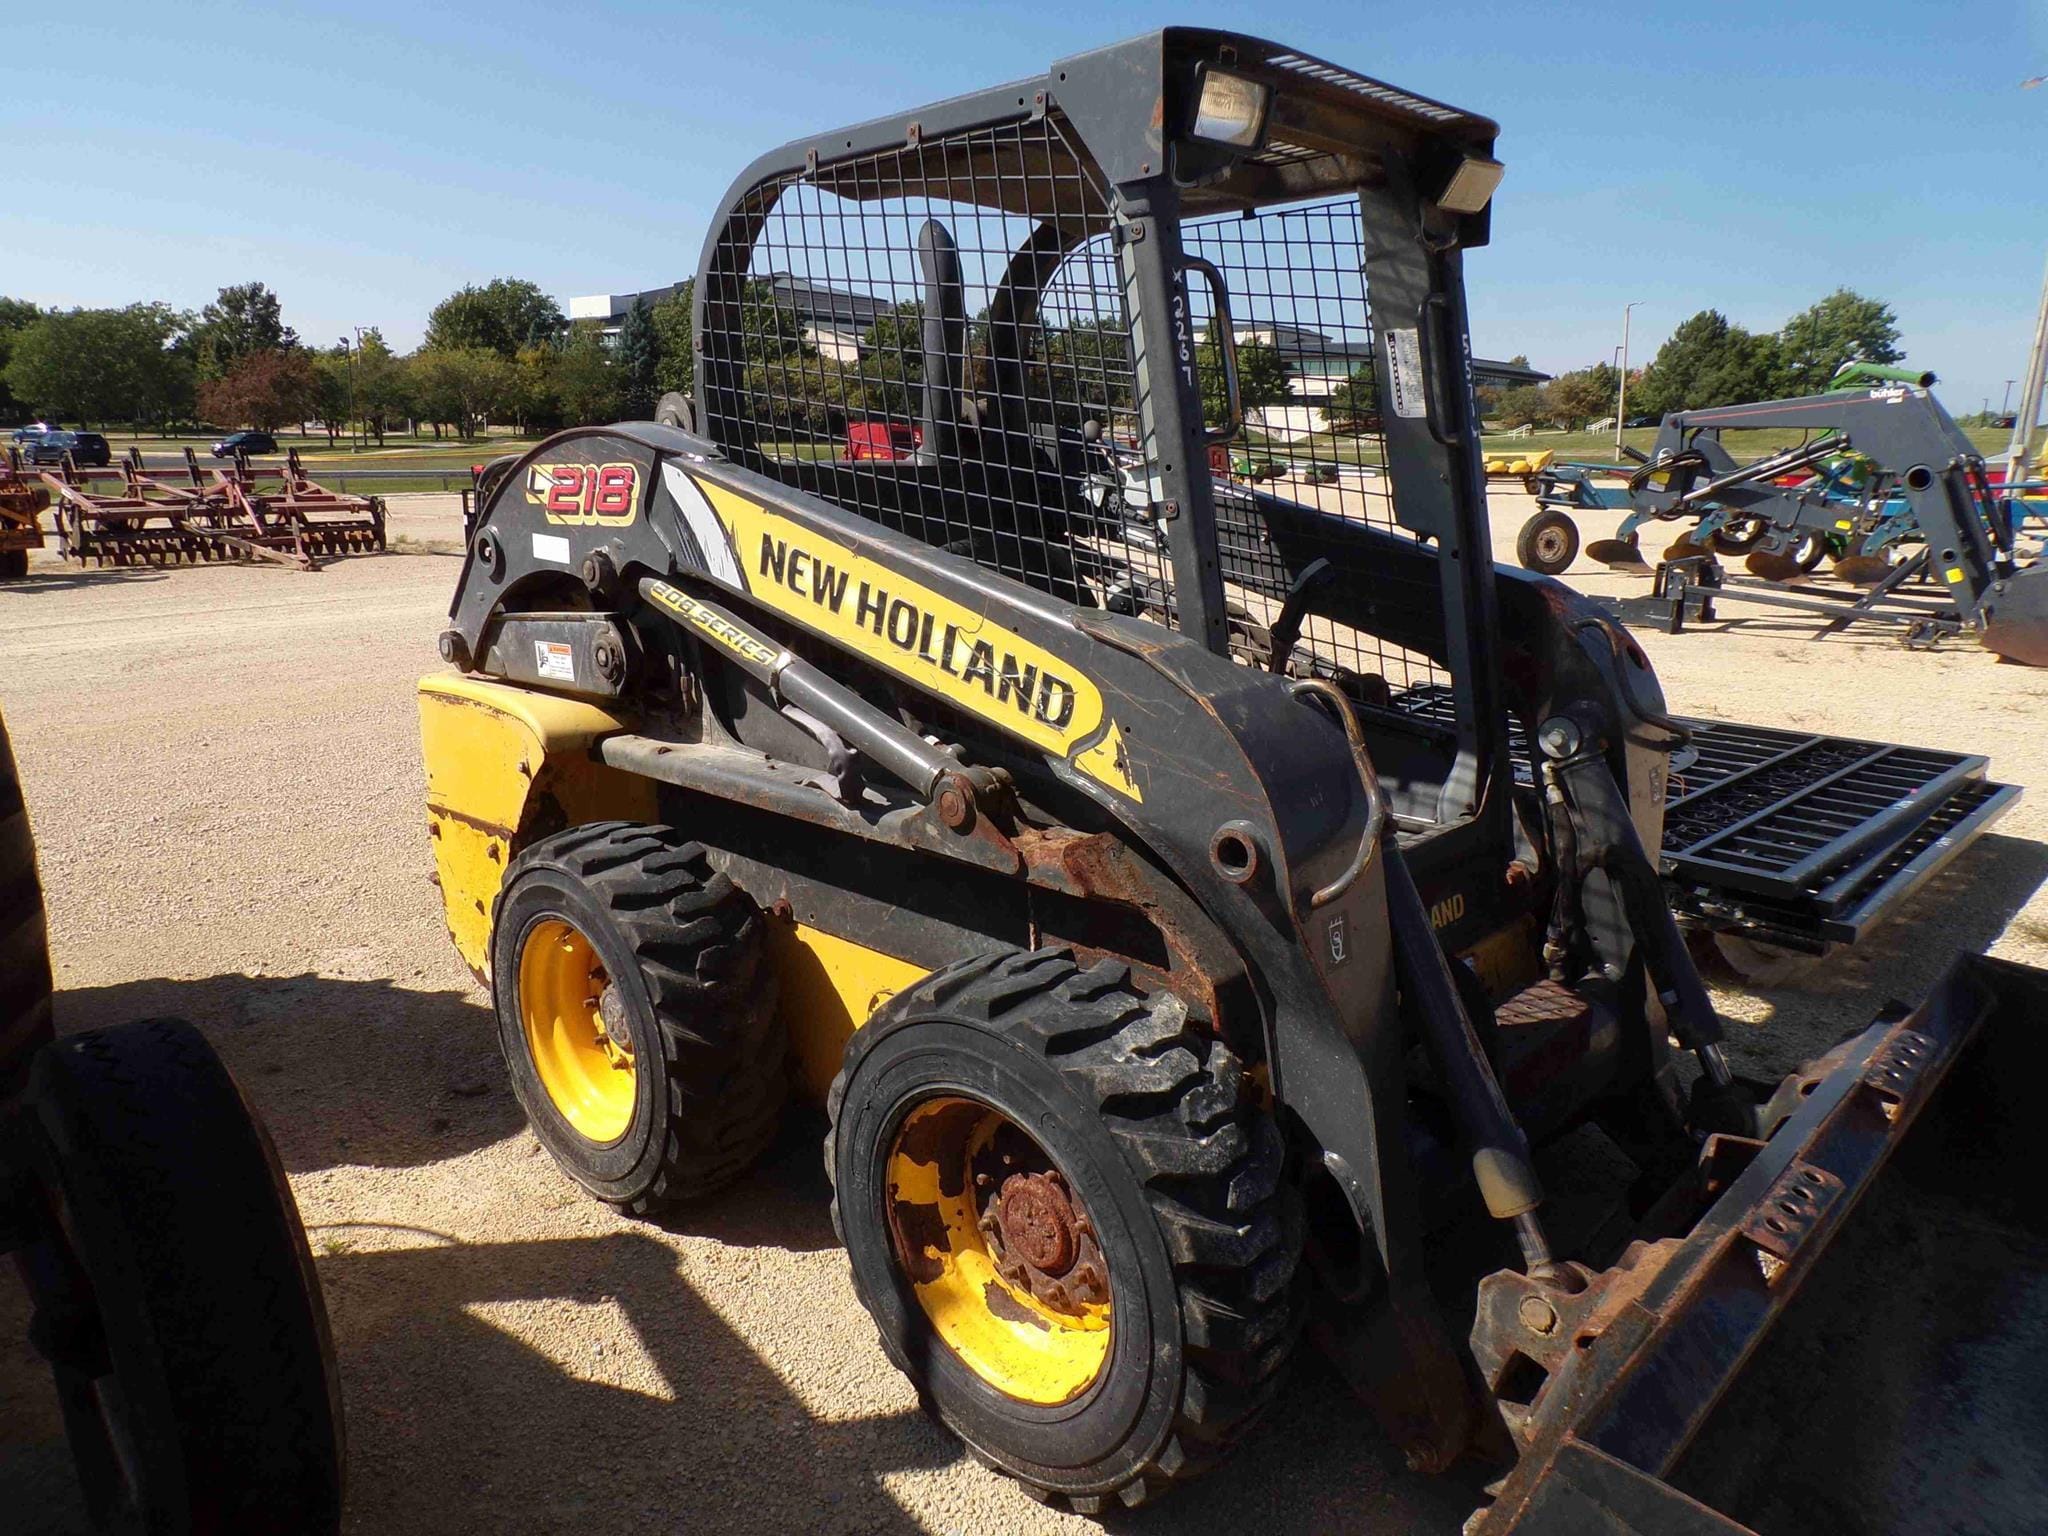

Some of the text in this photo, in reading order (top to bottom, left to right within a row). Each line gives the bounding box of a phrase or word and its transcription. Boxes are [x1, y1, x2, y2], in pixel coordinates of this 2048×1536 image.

[528, 465, 638, 520] L218
[695, 609, 776, 665] SERIES
[758, 531, 1078, 731] NEW HOLLAND
